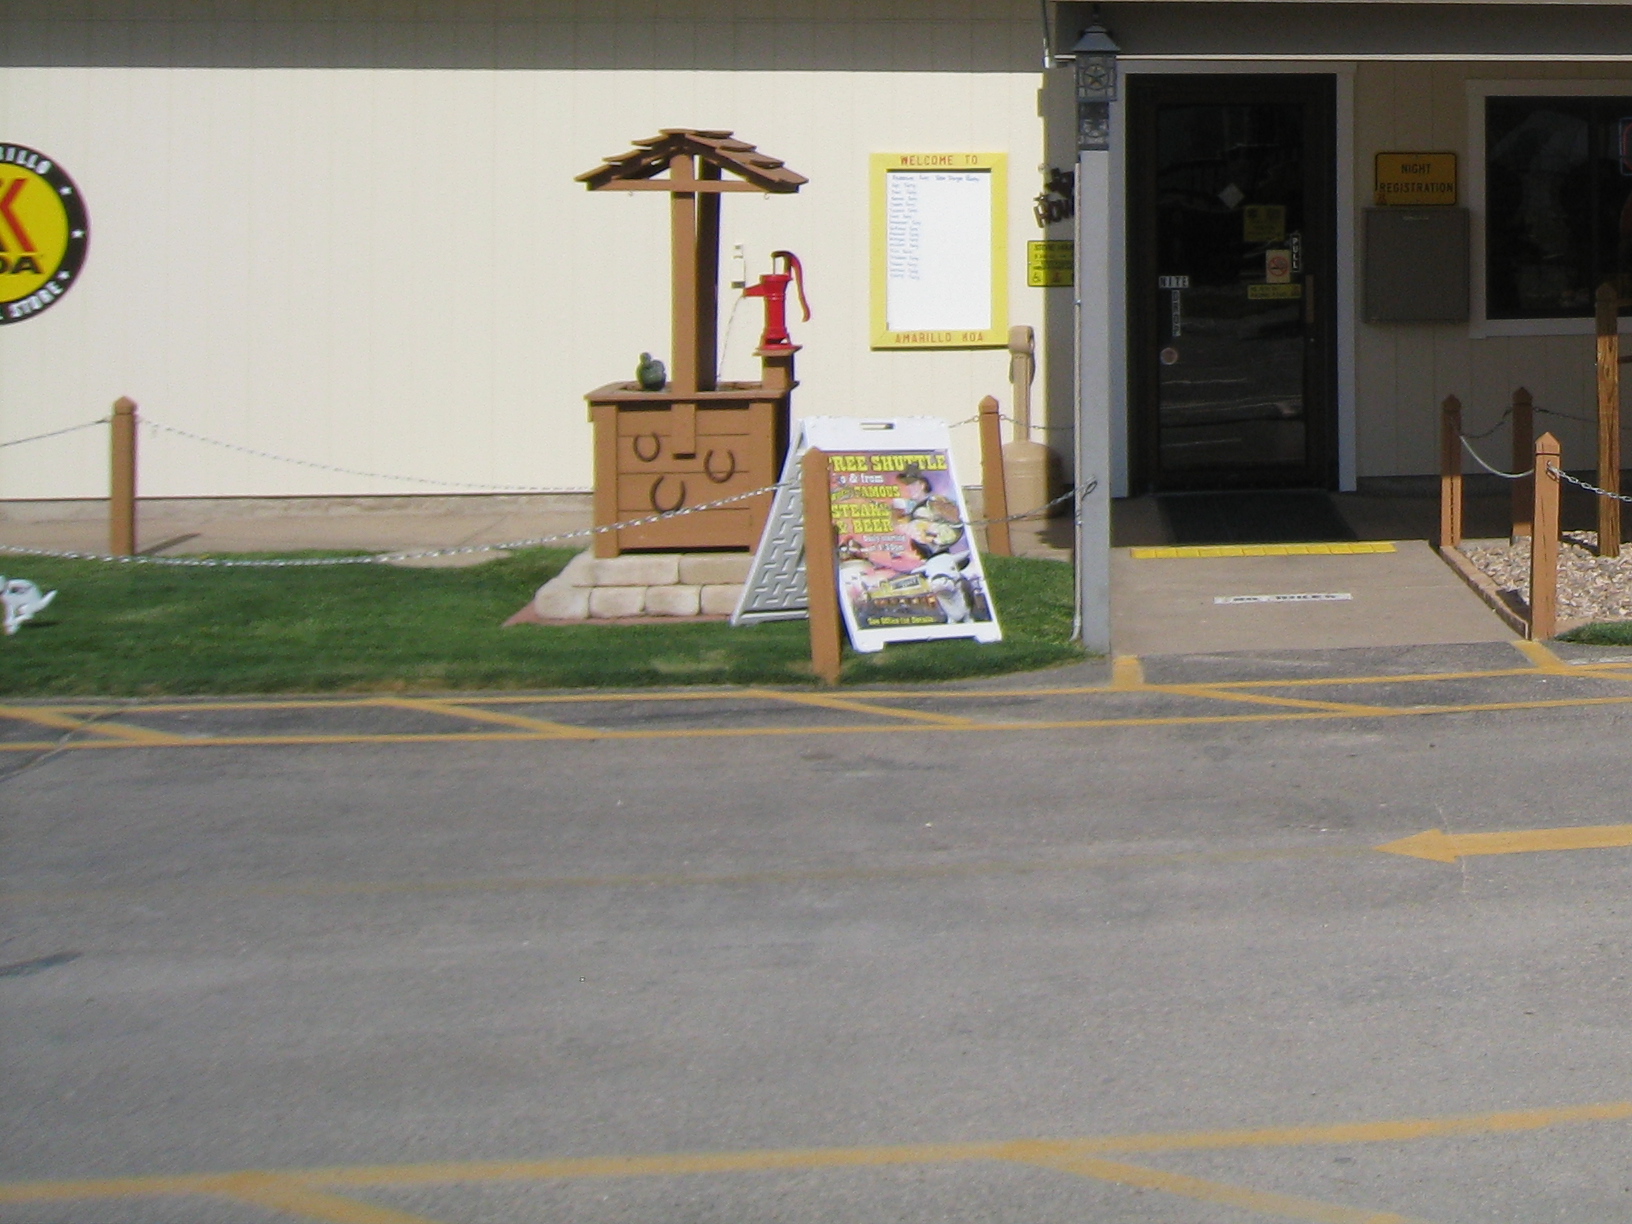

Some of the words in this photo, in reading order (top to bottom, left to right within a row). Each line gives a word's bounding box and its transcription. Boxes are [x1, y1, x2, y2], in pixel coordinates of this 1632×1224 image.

[900, 155, 954, 166] WELCOME
[965, 155, 978, 165] TO
[1401, 163, 1431, 174] NIGHT
[1380, 183, 1455, 193] REGISTRATION
[1159, 277, 1188, 287] NITE
[8, 280, 64, 319] STORE
[895, 331, 952, 344] AMARILLO
[962, 331, 985, 342] KOA
[871, 455, 948, 471] SHUTTLE
[861, 473, 884, 484] from
[854, 485, 901, 498] FAMOUS
[852, 518, 894, 534] BEER
